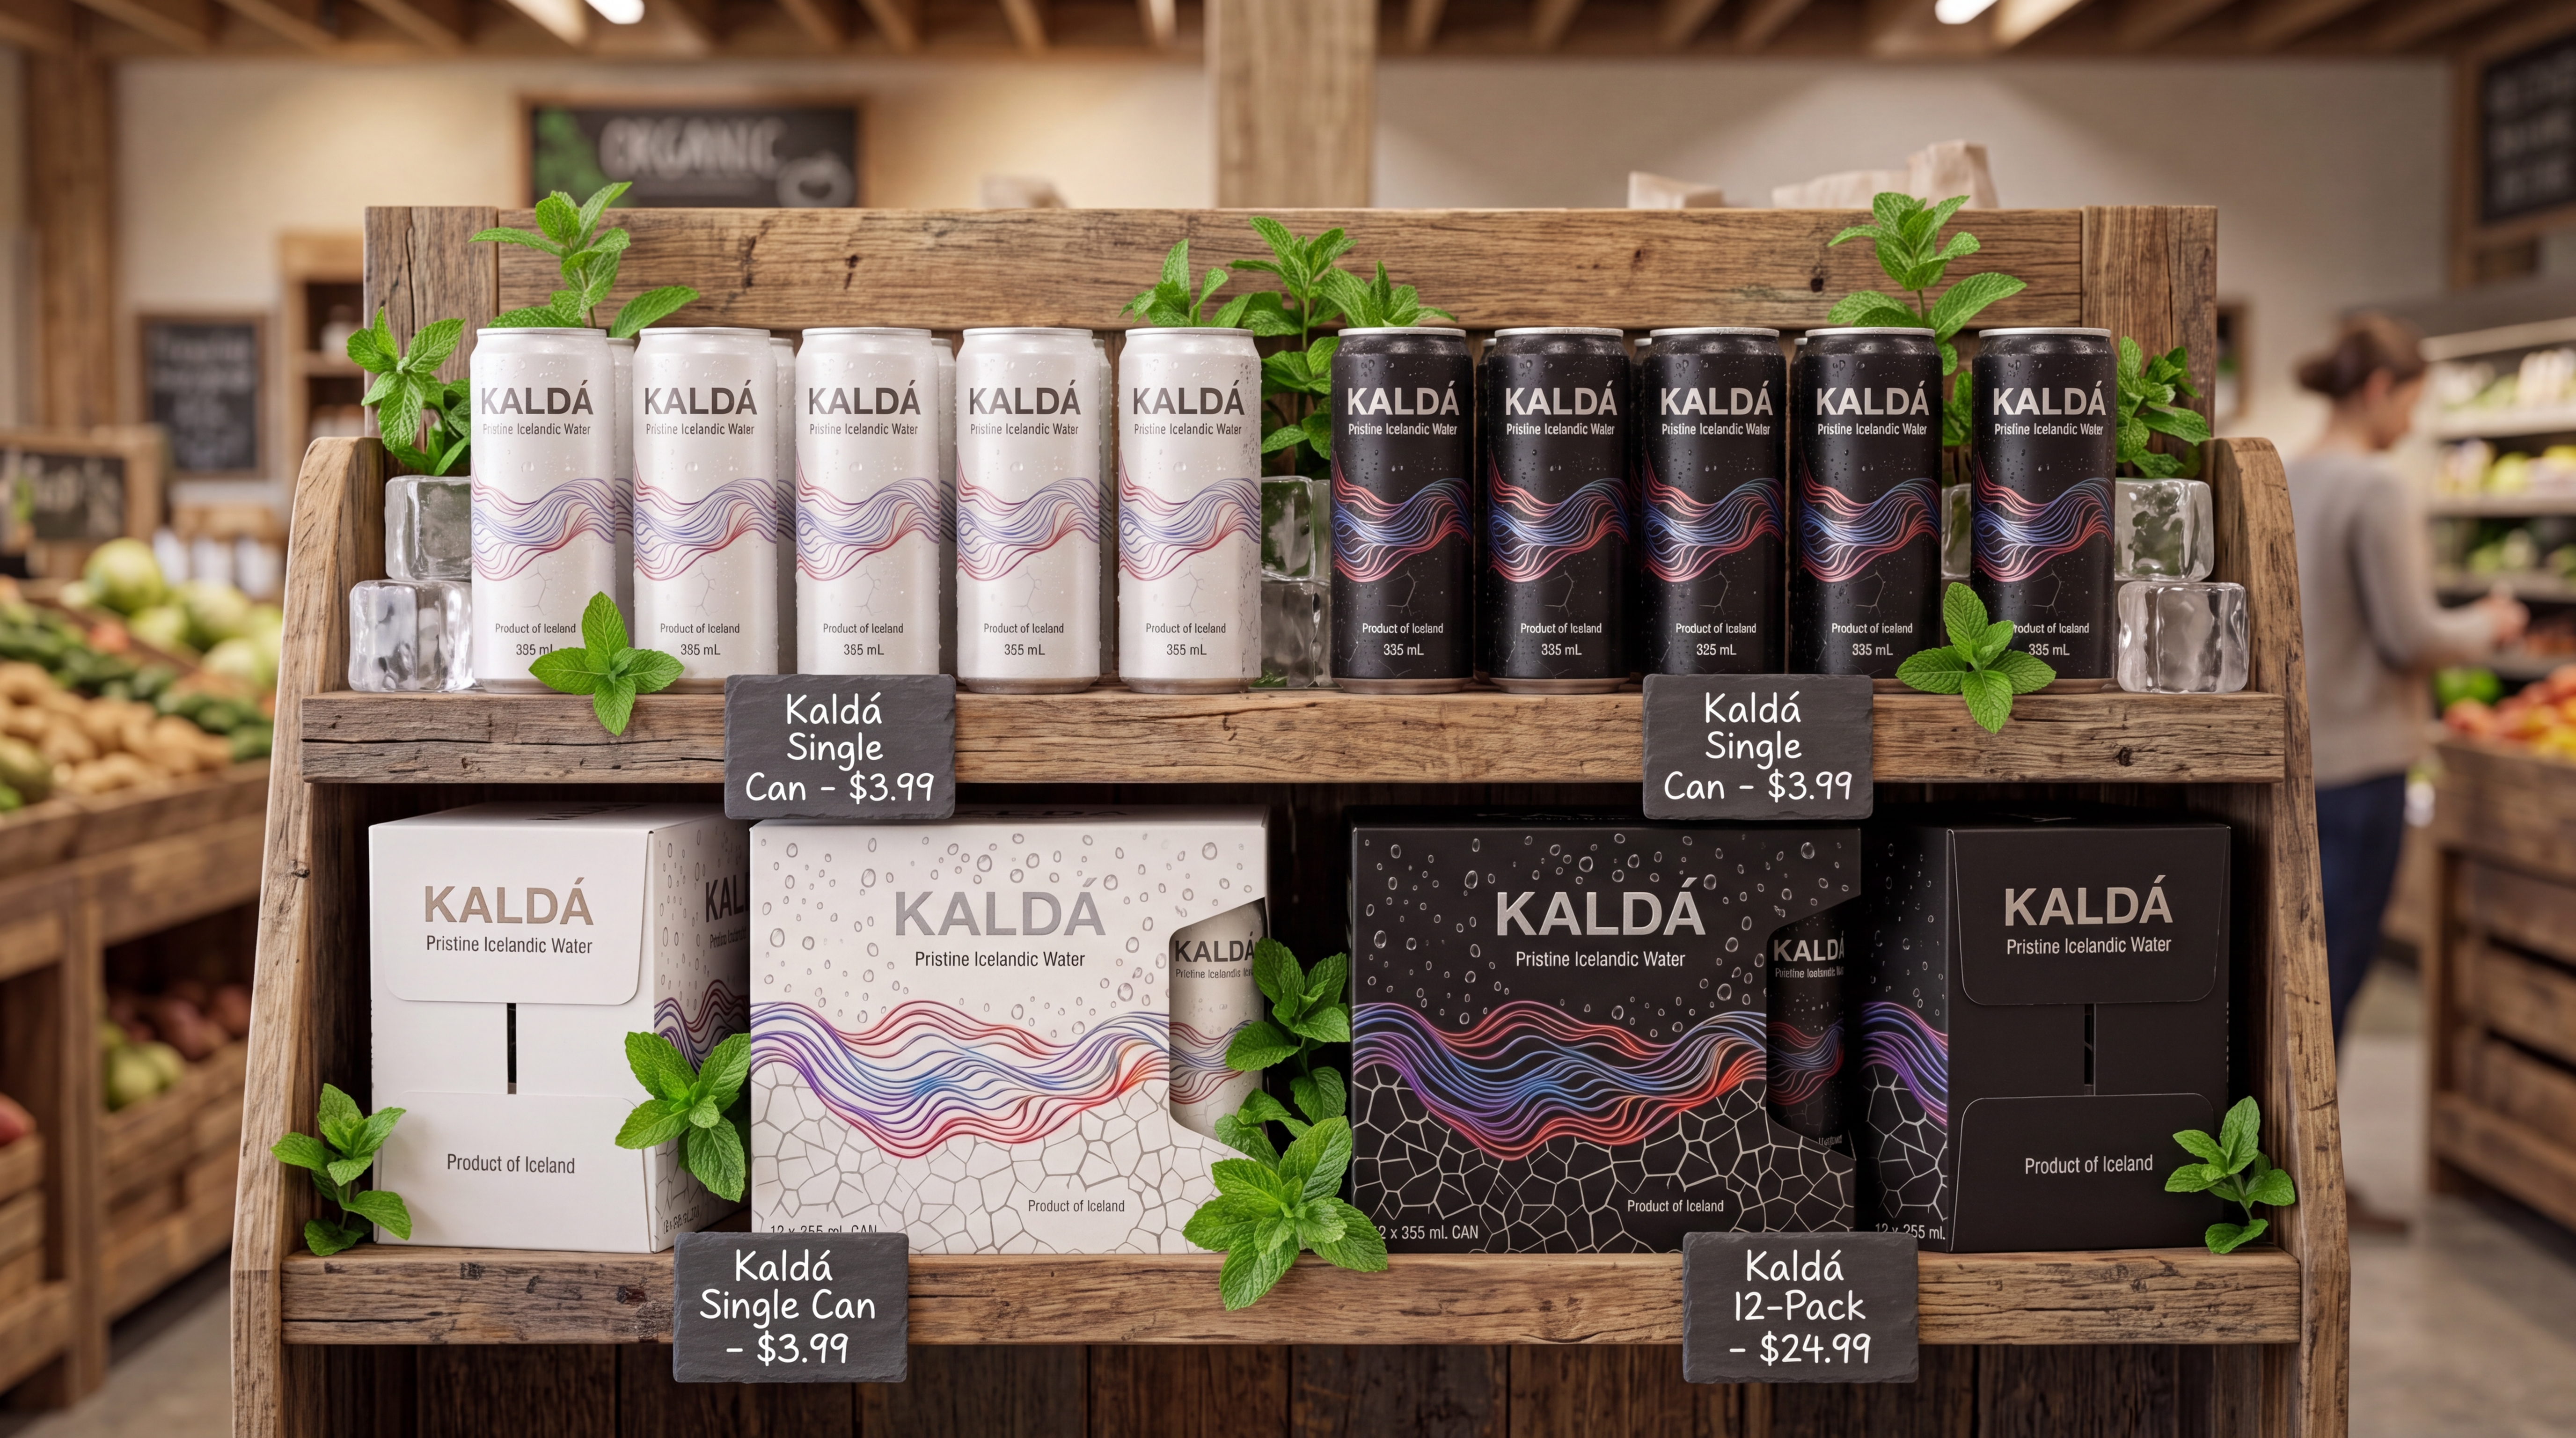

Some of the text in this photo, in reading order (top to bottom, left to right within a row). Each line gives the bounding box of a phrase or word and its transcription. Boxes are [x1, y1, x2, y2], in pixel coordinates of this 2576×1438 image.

[481, 380, 593, 415] KALDÁ
[645, 380, 757, 415] KALDÁ
[809, 380, 921, 415] KALDÁ
[970, 380, 1081, 415] KALDÁ
[1134, 380, 1244, 415] KALDÁ
[1348, 380, 1459, 415] KALDÁ
[1506, 380, 1617, 415] KALDÁ
[1661, 380, 1773, 415] KALDÁ
[1817, 380, 1929, 415] KALDÁ
[1993, 380, 2106, 415] KALDÁ
[518, 423, 561, 435] Icelandic
[564, 423, 591, 435] Water
[646, 423, 677, 435] Pristine
[682, 423, 725, 435] Icelandic
[810, 423, 918, 435] Pristine Icelandic Water
[971, 423, 1078, 435] Pristine Icelandic Water
[1134, 423, 1242, 435] Pristine Icelandic Water
[1349, 423, 1382, 435] Pristine
[1386, 423, 1429, 435] Icelandic
[1507, 423, 1541, 435] Pristine
[1545, 423, 1588, 435] Icelandic
[1700, 423, 1743, 435] Icelandic
[1818, 423, 1852, 435] Pristine
[1856, 423, 1899, 435] Icelandic
[1995, 423, 2030, 435] Pristine
[2034, 423, 2077, 435] Icelandic
[495, 623, 576, 633] Product of Iceland
[660, 623, 740, 633] Product of Iceland
[823, 623, 903, 633] Product of Iceland
[984, 623, 1064, 633] Product of Iceland
[1146, 623, 1226, 633] Product of Iceland
[1362, 623, 1398, 633] Product
[1400, 623, 1410, 633] of
[1521, 623, 1556, 633] Product
[1559, 623, 1568, 633] of
[1676, 623, 1711, 633] Product
[1714, 623, 1723, 633] of
[1832, 623, 1867, 633] Product
[1870, 623, 1879, 633] of
[2014, 623, 2044, 633] roduct
[2047, 623, 2056, 633] of
[681, 644, 721, 655] 385 mL
[867, 644, 884, 655] mL
[1028, 644, 1045, 655] mL
[1190, 644, 1207, 655] mL
[1384, 644, 1424, 655] 335 mL
[1565, 644, 1582, 655] mL
[1720, 644, 1737, 655] mL
[1876, 644, 1893, 655] mL
[2053, 644, 2070, 655] mL
[787, 691, 882, 725] Kaldá
[1706, 690, 1801, 723] Kaldá
[787, 732, 884, 771] Single
[1705, 730, 1802, 770] Single
[746, 772, 806, 801] Can
[849, 770, 934, 805] $3.99
[1664, 770, 1724, 800] Can
[1768, 768, 1852, 803] $3.99
[425, 877, 594, 925] KALDÁ
[895, 877, 1106, 936] KALDÁ
[1497, 878, 1706, 936] KALDÁ
[2005, 875, 2173, 926] KALDÁ
[427, 935, 593, 954] Pristine Icelandic Water
[1175, 931, 1255, 962] KALDÁ
[1774, 930, 1844, 961] KALDÁ
[2007, 937, 2172, 955] Pristine Icelandic Water
[916, 951, 1085, 966] Pristine Icelandic Water
[1516, 951, 1686, 967] Pristine Icelandic Water
[447, 1153, 575, 1174] Product of Iceland
[2025, 1154, 2153, 1174] Product of Iceland
[1029, 1199, 1125, 1212] Product of Iceland
[1628, 1199, 1724, 1212] Product of Iceland
[1374, 1225, 1386, 1239] 2
[1390, 1228, 1398, 1239] x
[1401, 1225, 1425, 1239] 355
[1452, 1225, 1478, 1239] CAN
[736, 1249, 833, 1281] Kaldá
[1747, 1249, 1844, 1281] Kaldá
[700, 1288, 875, 1329] Single Can
[1735, 1290, 1866, 1321] 12-Pack
[757, 1330, 849, 1366] $3.99
[1760, 1330, 1871, 1366] $24.99
